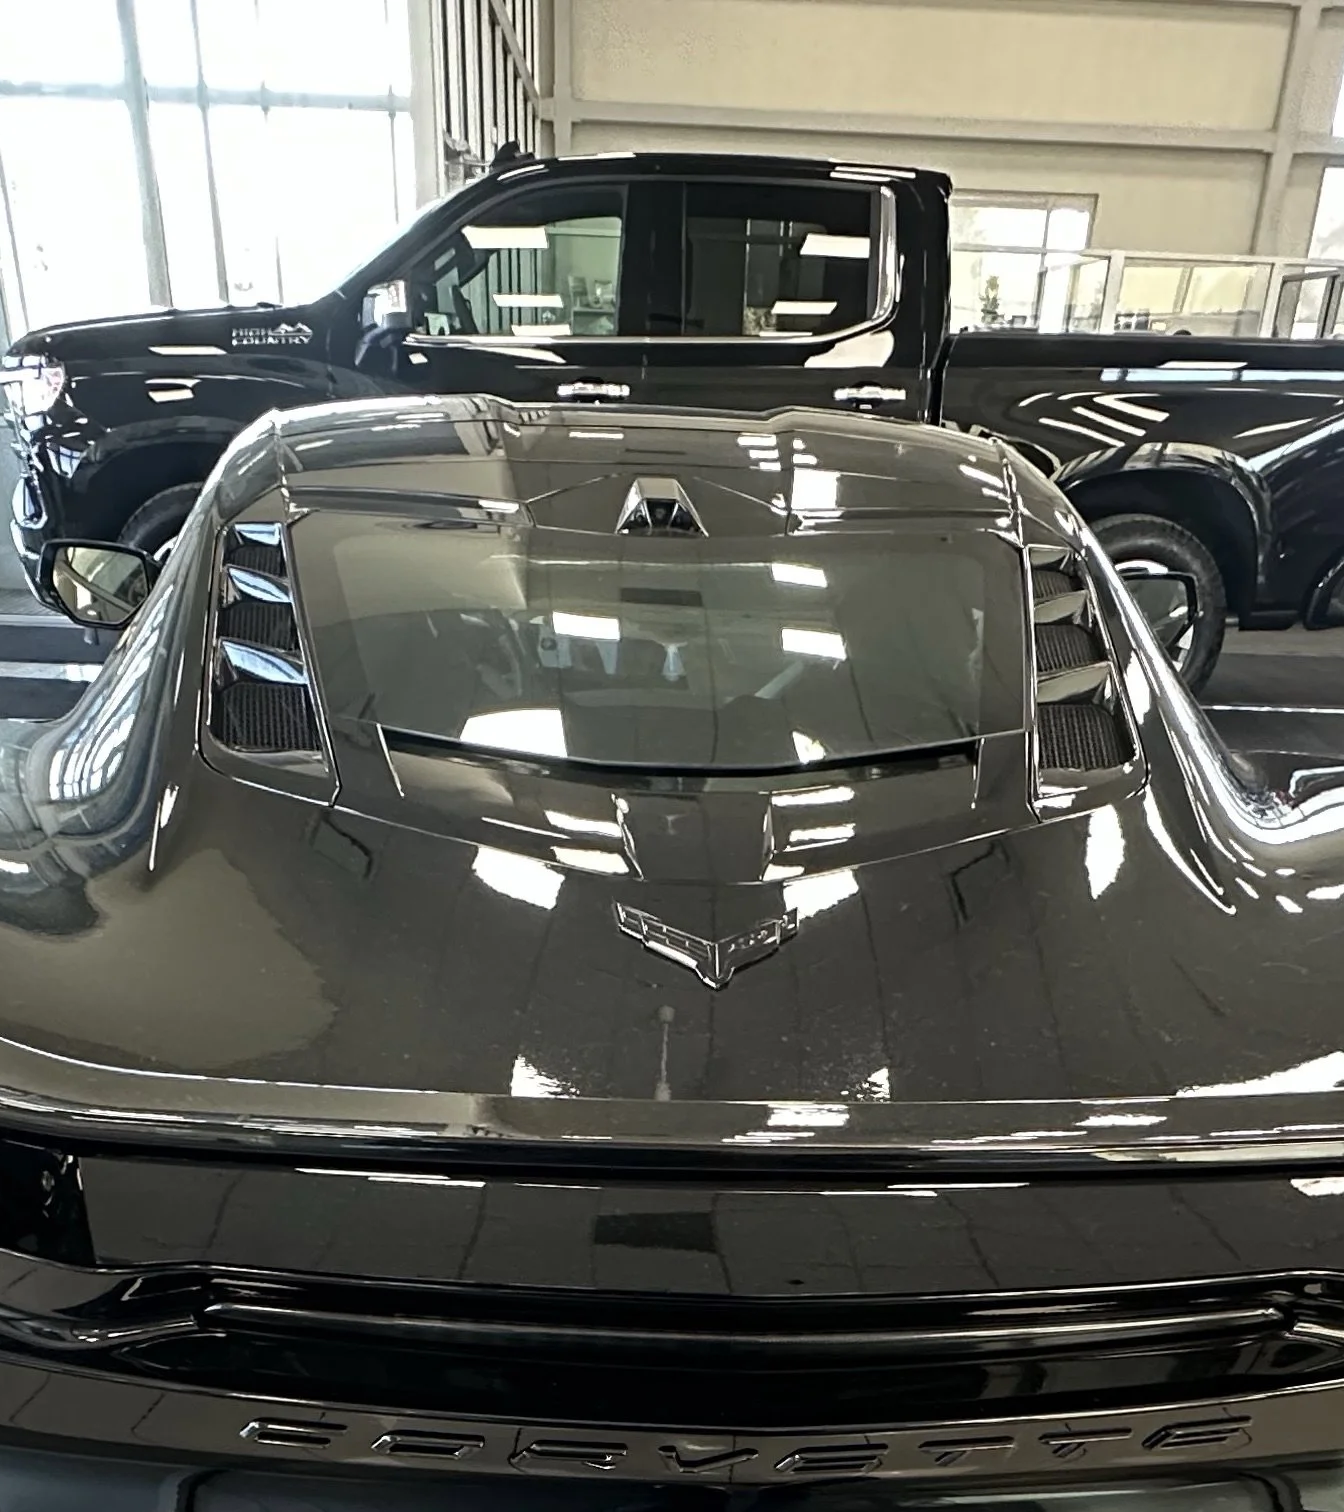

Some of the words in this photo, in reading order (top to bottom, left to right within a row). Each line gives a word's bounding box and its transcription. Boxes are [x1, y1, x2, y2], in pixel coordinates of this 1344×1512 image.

[231, 328, 272, 337] HIGH
[231, 335, 312, 346] COUNTRY
[239, 1413, 1253, 1475] CORVETTE
